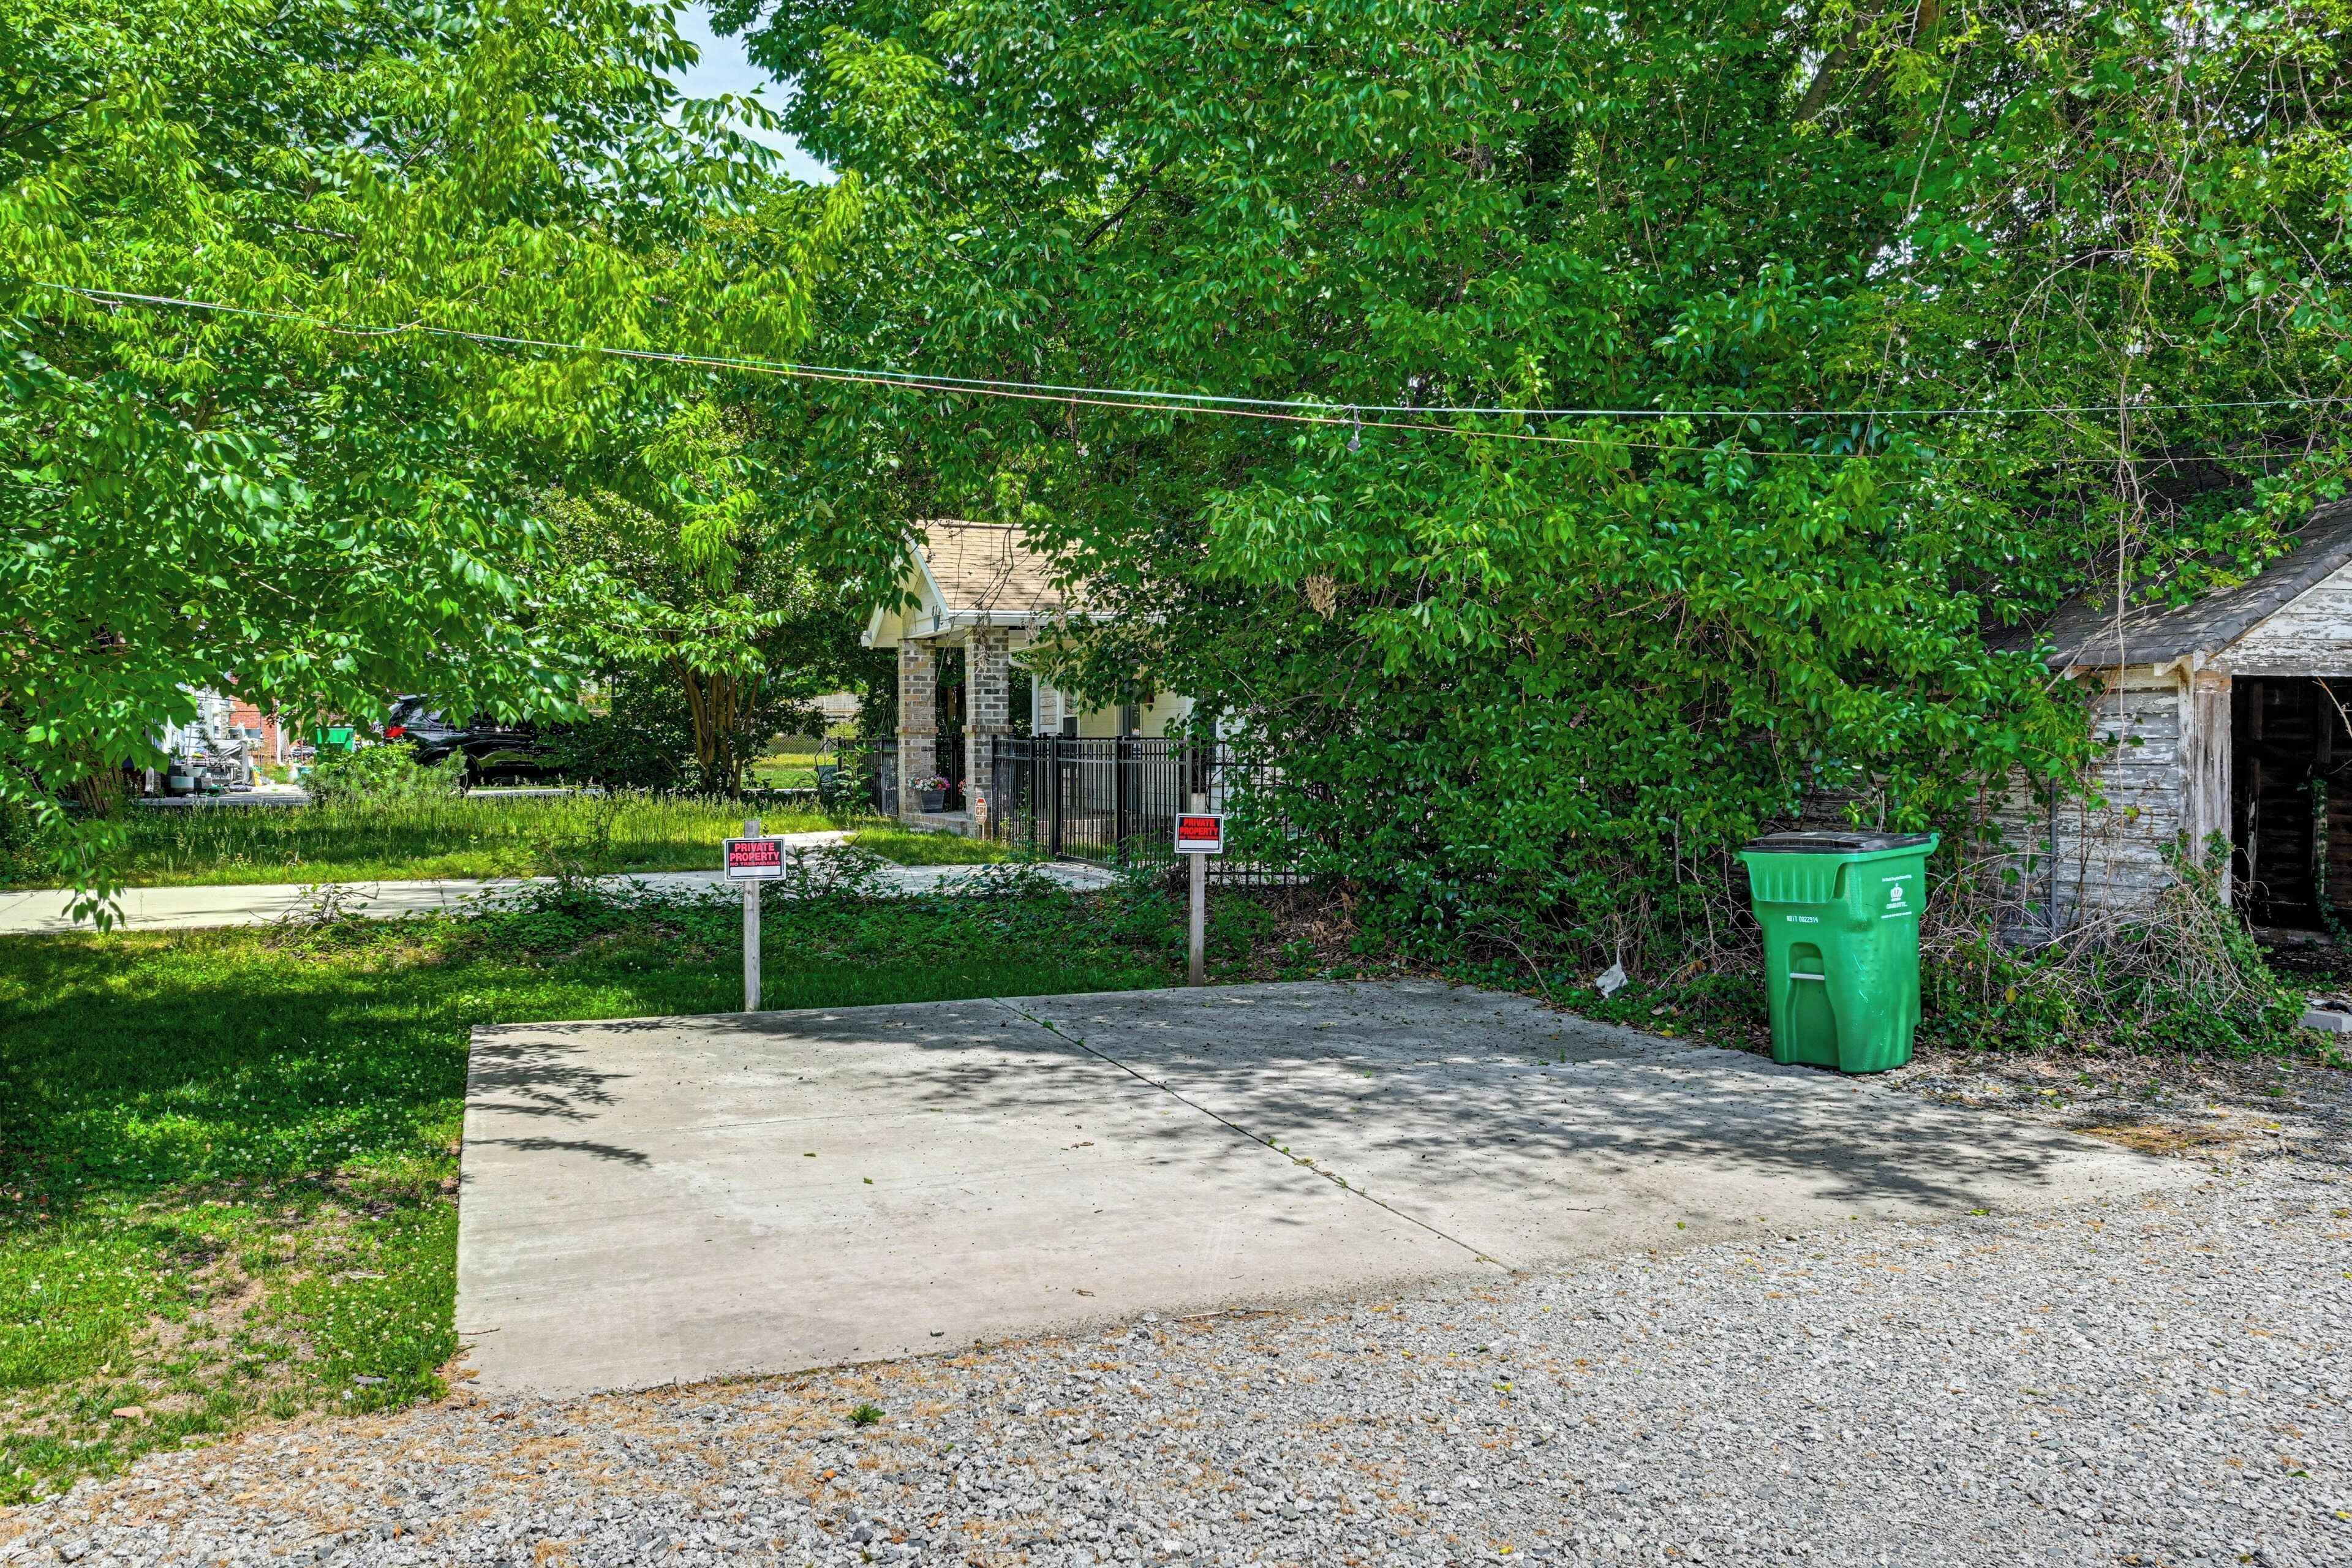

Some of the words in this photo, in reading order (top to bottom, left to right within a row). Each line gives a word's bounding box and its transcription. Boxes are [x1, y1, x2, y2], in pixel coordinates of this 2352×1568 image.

[976, 807, 986, 815] CPI
[1183, 818, 1216, 827] PRIVATE
[1179, 826, 1218, 835] PROPERTY
[734, 842, 775, 852] PRIVATE
[729, 851, 780, 862] PROPERTY
